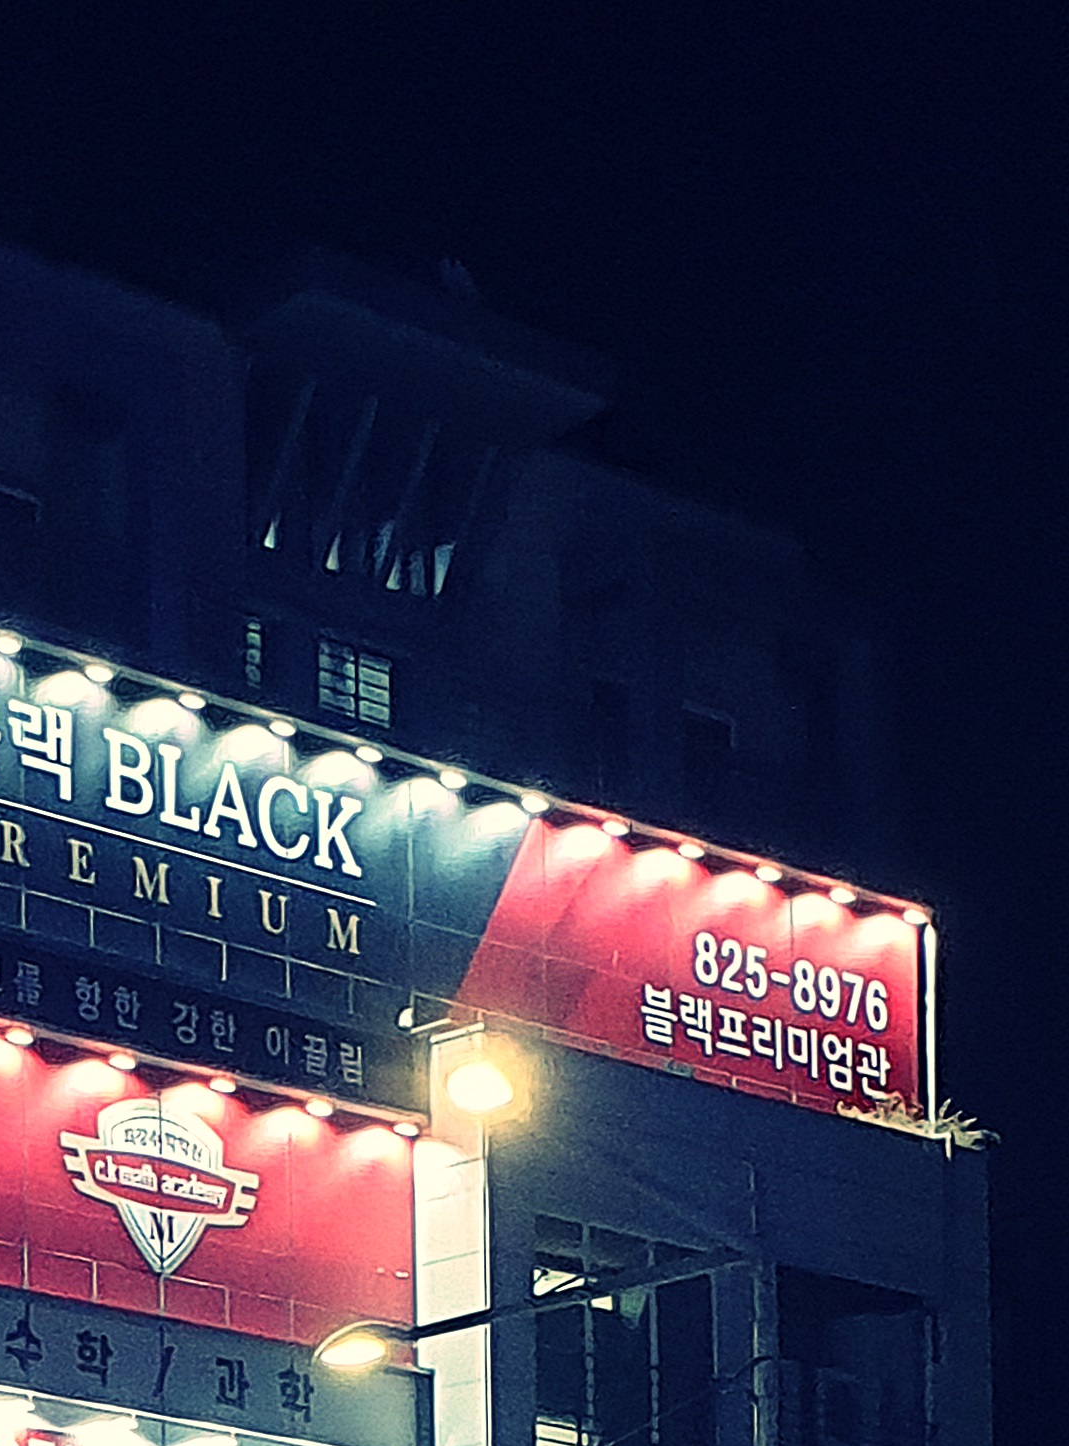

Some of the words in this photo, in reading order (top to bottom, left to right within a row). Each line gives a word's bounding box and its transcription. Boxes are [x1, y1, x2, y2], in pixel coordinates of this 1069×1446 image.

[104, 727, 362, 878] BLACK
[76, 977, 139, 1031] 향한
[173, 1001, 235, 1053] 강한
[266, 1026, 363, 1087] 이끌림
[694, 931, 888, 1031] 825-8976
[641, 983, 891, 1098] 블랙프리미엄관
